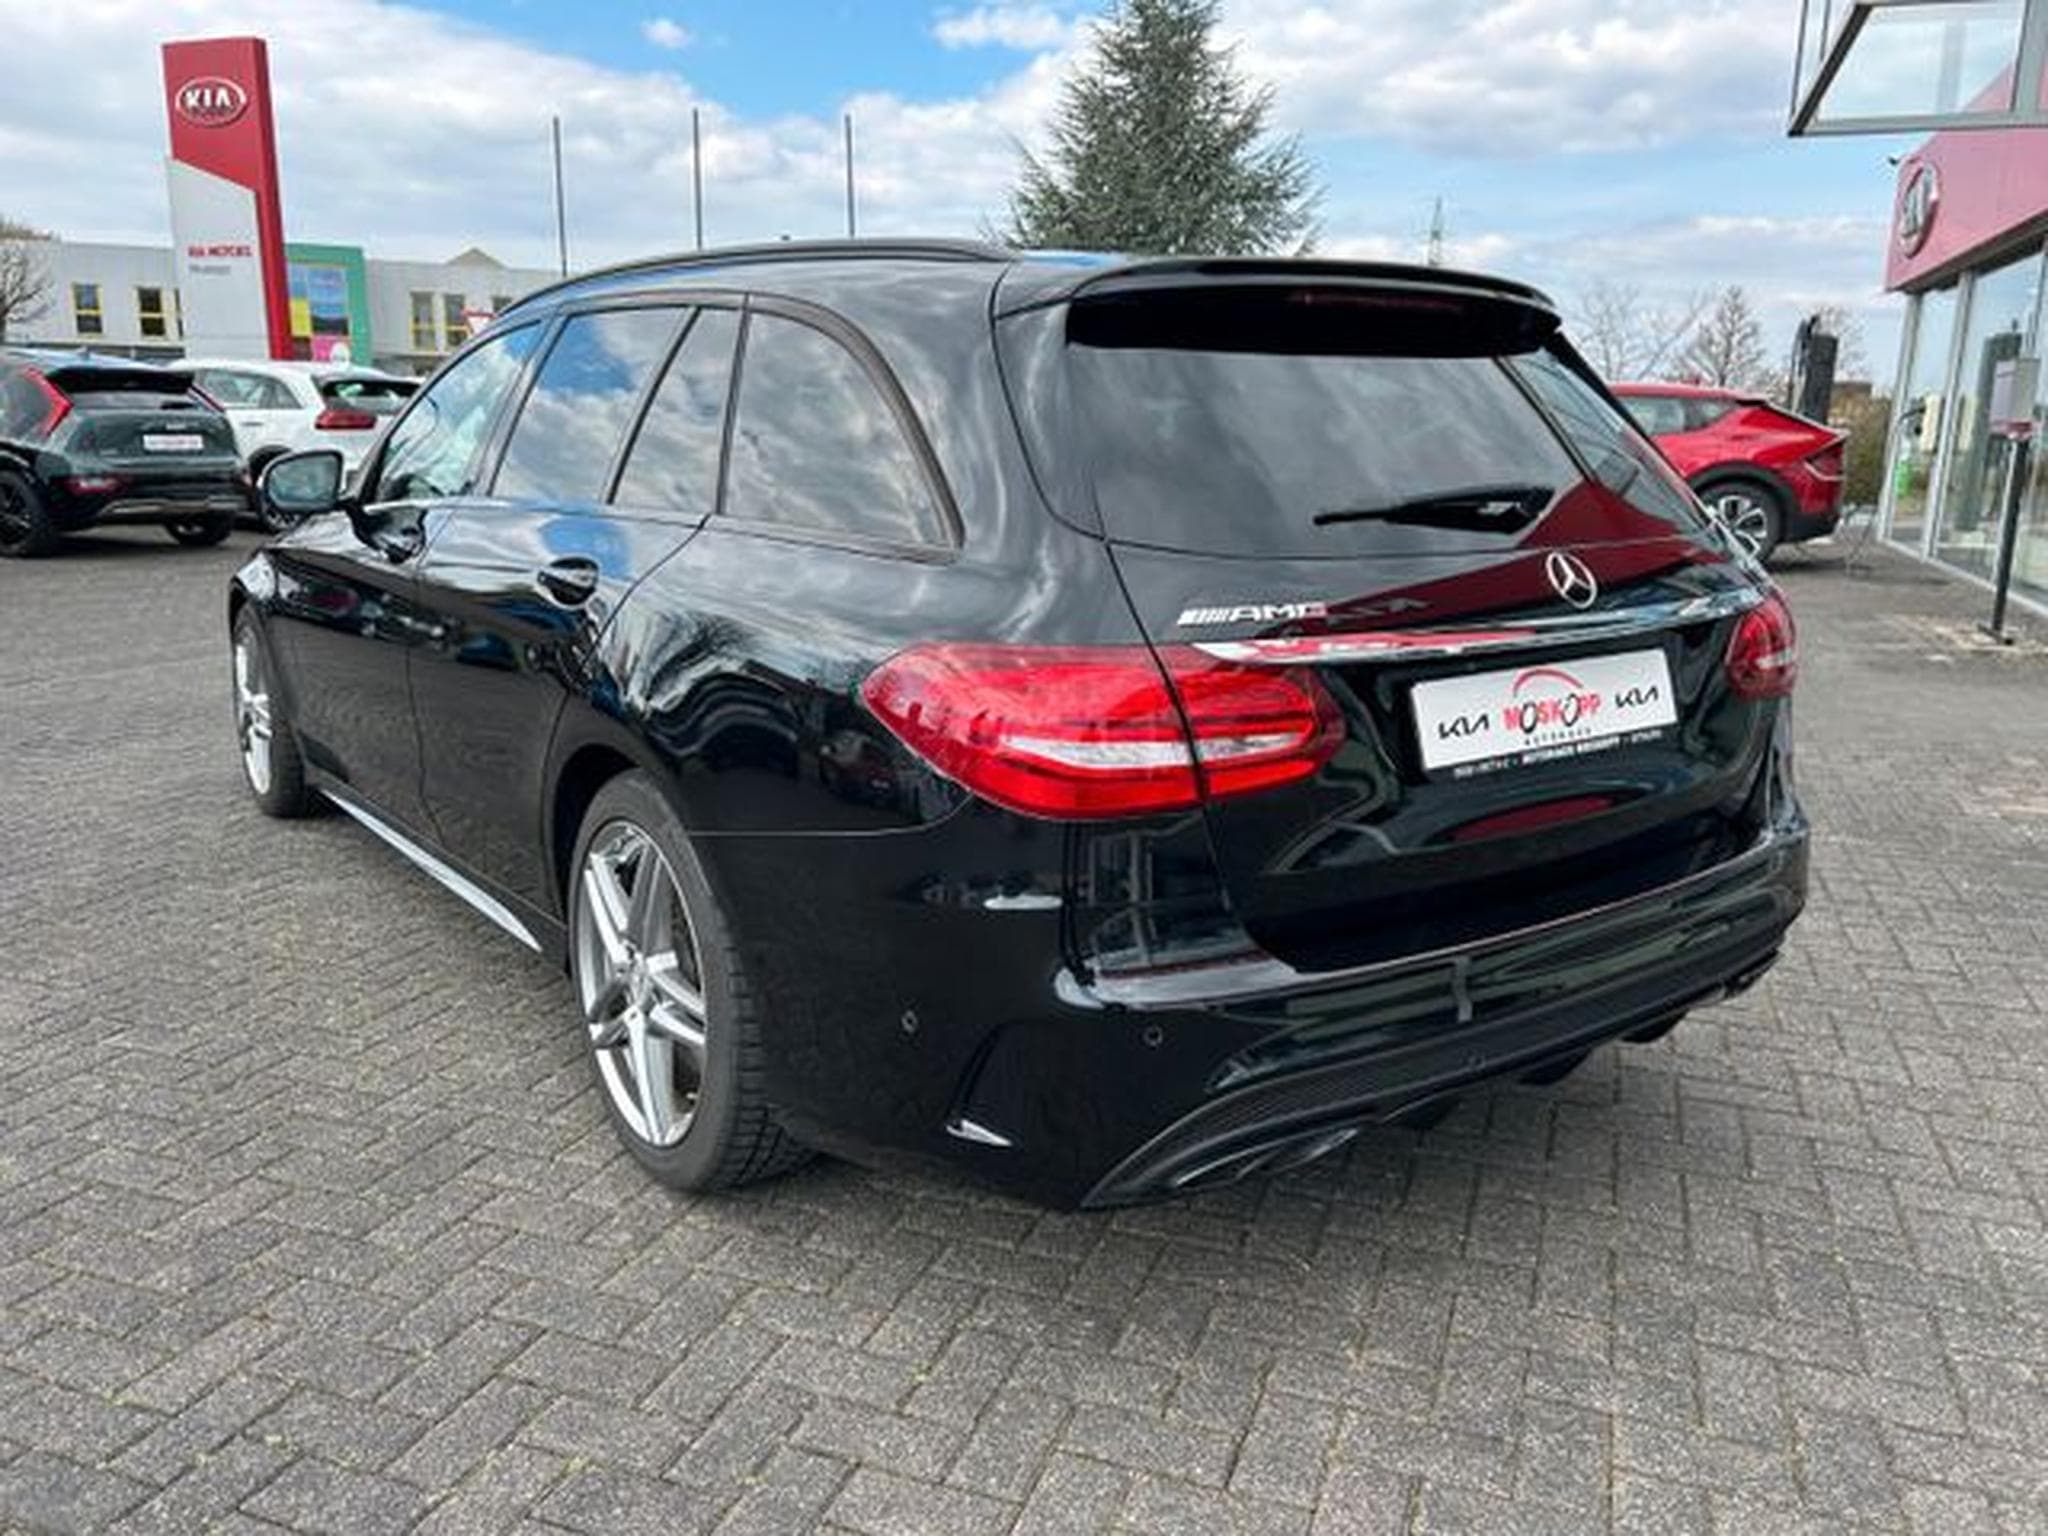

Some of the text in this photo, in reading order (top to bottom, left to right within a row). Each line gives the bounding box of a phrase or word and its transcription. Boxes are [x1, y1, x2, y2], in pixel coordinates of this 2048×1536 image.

[185, 87, 232, 109] KIA
[1229, 601, 1328, 623] AMG
[1437, 684, 1660, 741] KIA MOSKOPP KIA
